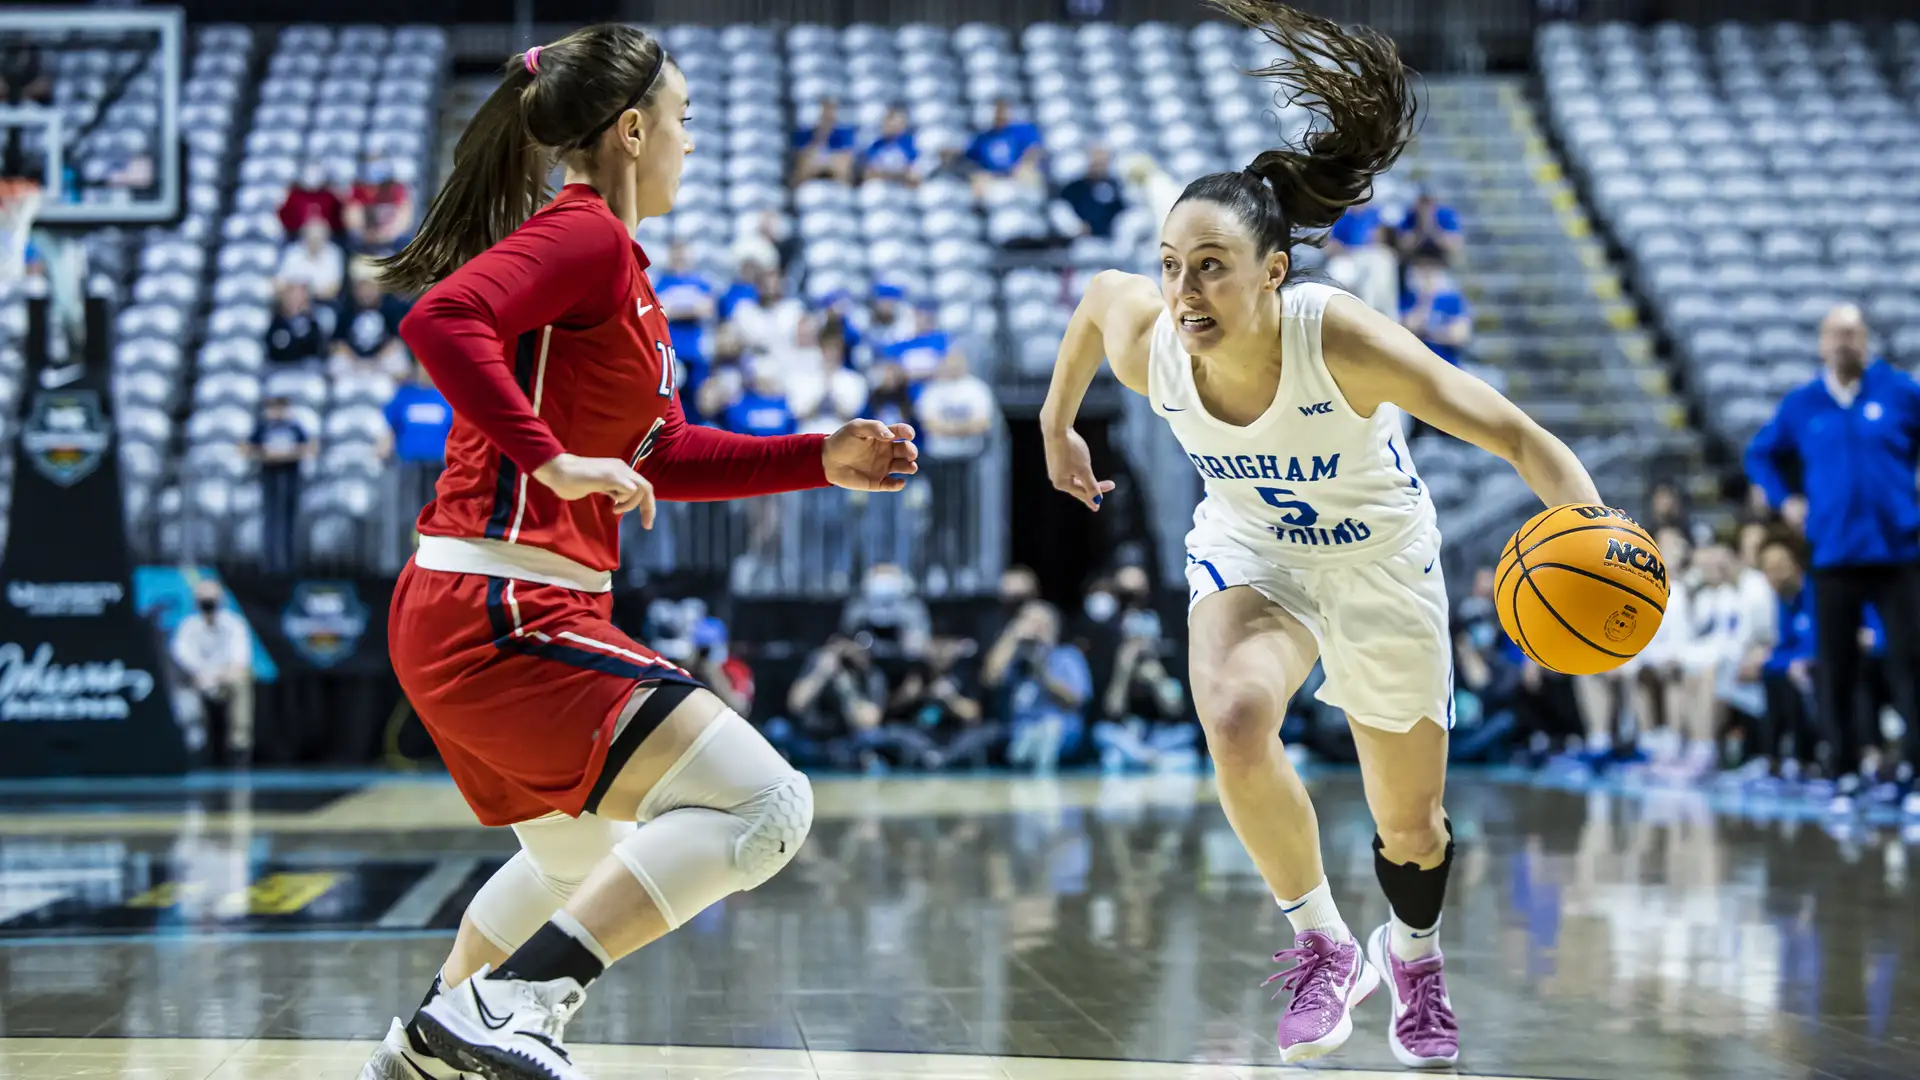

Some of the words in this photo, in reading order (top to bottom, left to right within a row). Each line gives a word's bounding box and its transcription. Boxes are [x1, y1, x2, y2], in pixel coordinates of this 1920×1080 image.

[1297, 400, 1334, 417] WCC
[1189, 452, 1341, 482] BRIGHAM
[1253, 486, 1320, 527] 5
[1603, 561, 1637, 576] OFFICIAL
[1604, 537, 1667, 590] NCAA
